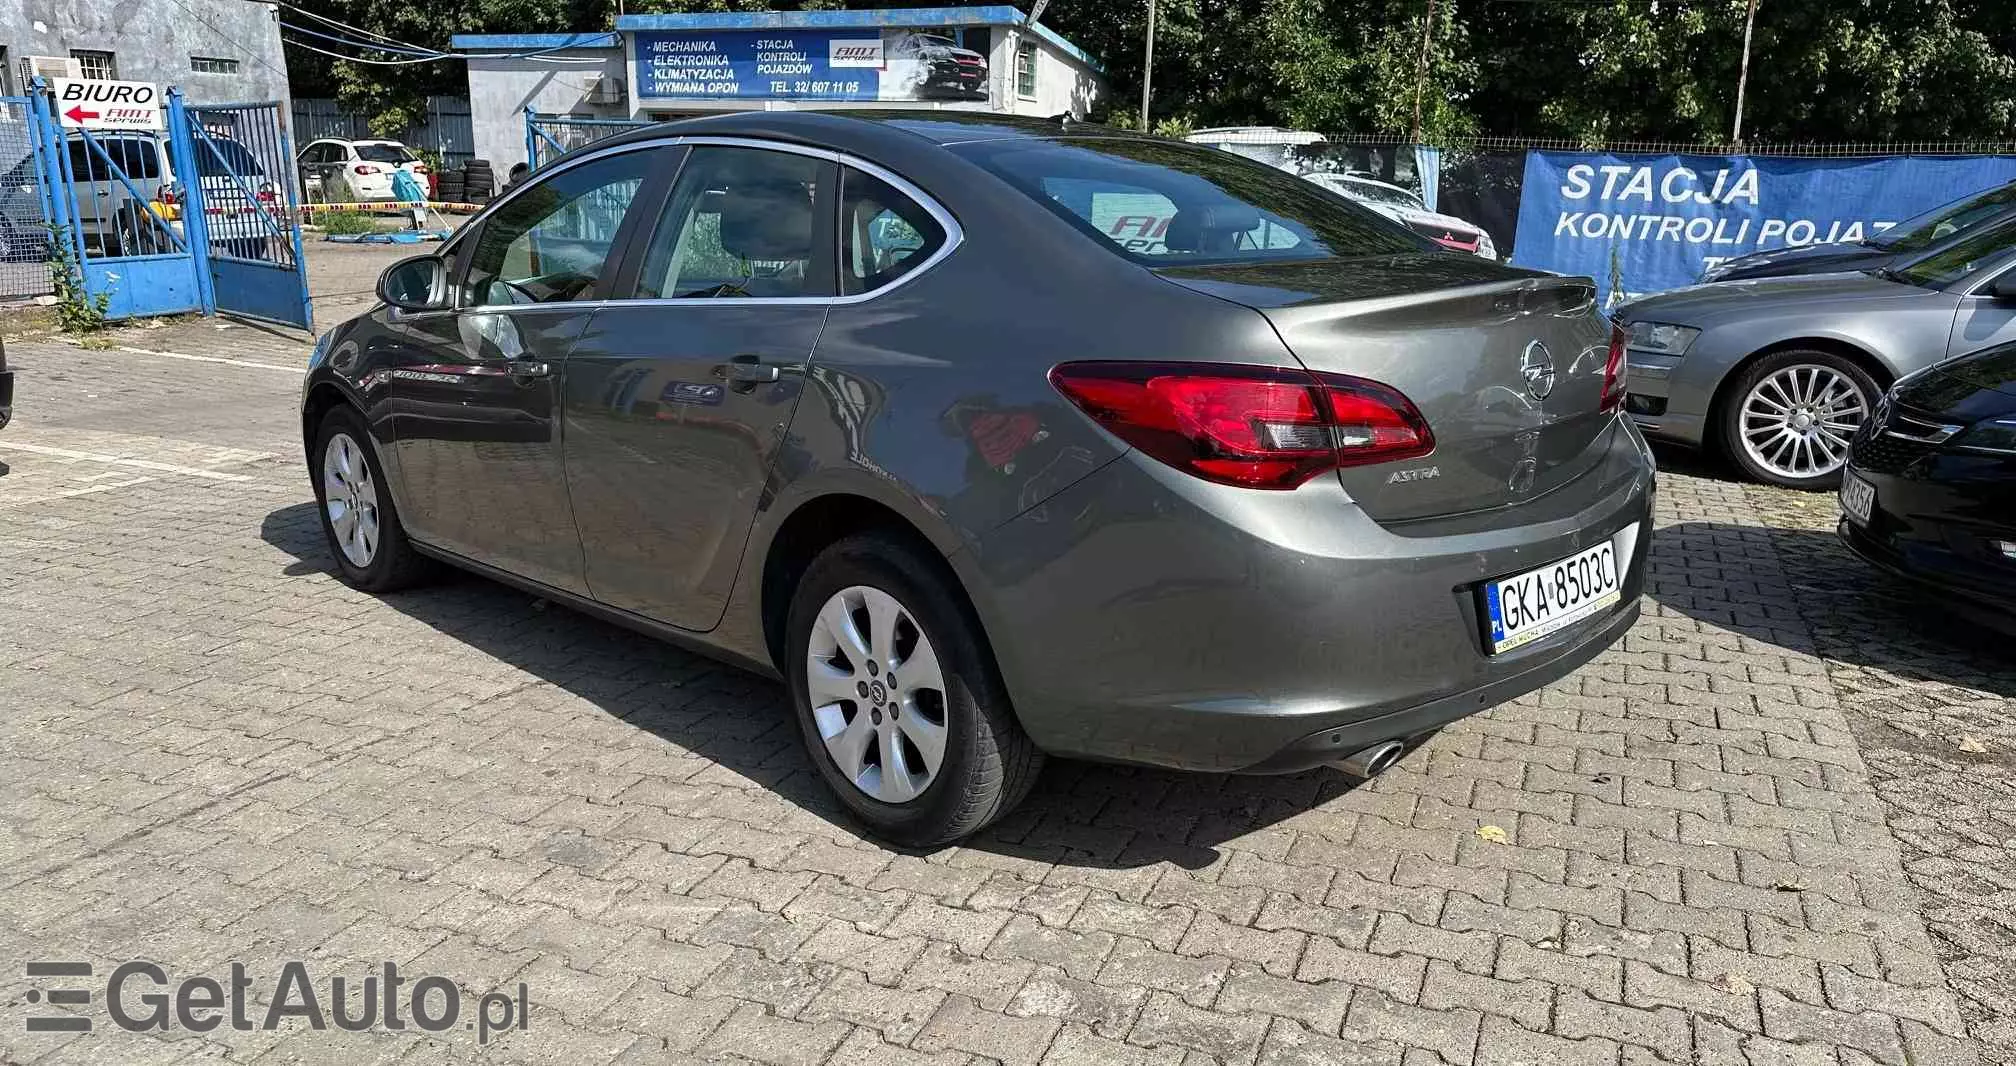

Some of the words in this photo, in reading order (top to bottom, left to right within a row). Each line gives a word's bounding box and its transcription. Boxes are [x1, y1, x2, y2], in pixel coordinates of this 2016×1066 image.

[652, 41, 716, 52] MECHANIKA
[756, 40, 794, 50] STACJA
[653, 55, 729, 66] ELEKTRONIKA
[756, 52, 807, 62] KONTROLI
[654, 68, 734, 80] KLIMATYZACJA
[757, 62, 813, 74] POJAZDÓW
[655, 82, 705, 93] WYMIANA
[707, 82, 739, 93] OPON
[770, 81, 792, 93] TEL.
[794, 81, 810, 93] 32/
[811, 81, 829, 93] 607
[832, 81, 844, 93] 11
[846, 81, 860, 93] 05
[62, 83, 153, 104] BIURO
[1561, 164, 1760, 206] STACJA
[1554, 212, 1752, 246] KONTROLI
[1384, 465, 1441, 485] ASTRA
[1502, 574, 1550, 630] GKA
[1554, 547, 1615, 609] 8503C
[1491, 620, 1503, 634] PL
